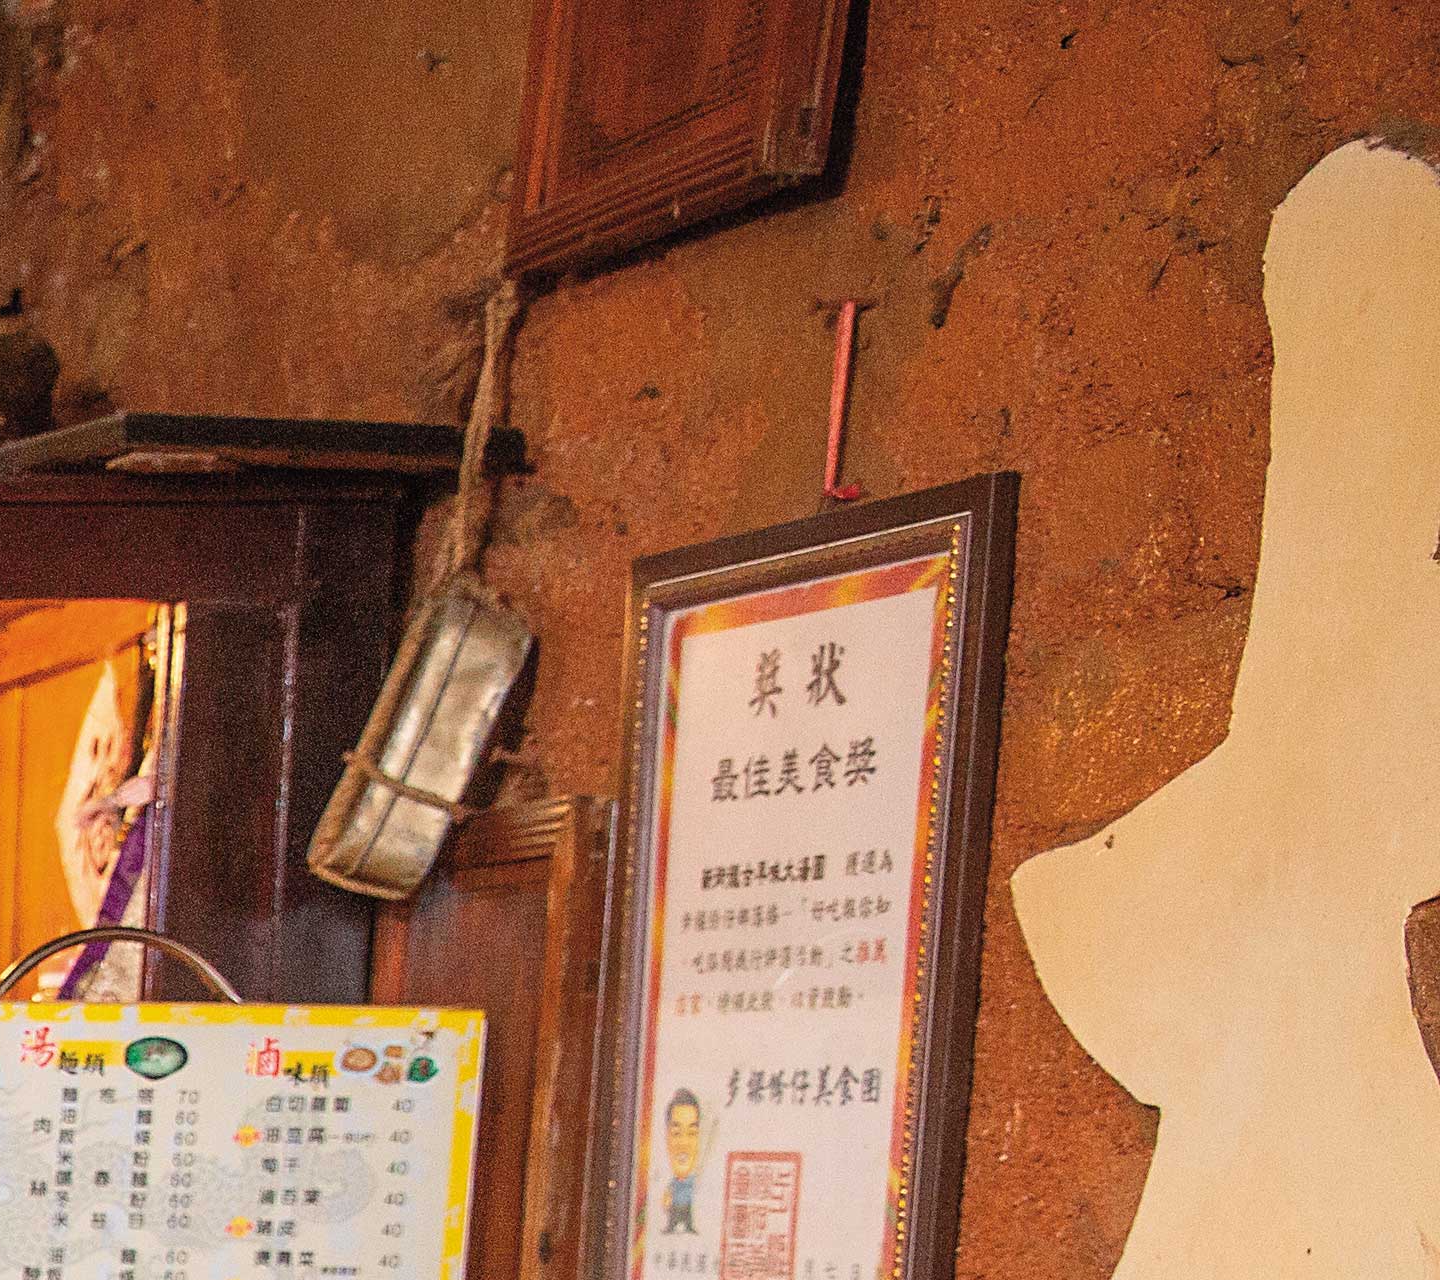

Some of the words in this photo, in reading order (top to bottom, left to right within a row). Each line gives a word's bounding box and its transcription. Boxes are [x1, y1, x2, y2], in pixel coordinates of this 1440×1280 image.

[748, 641, 848, 719] 獎狀
[711, 737, 879, 803] 最佳美食獎
